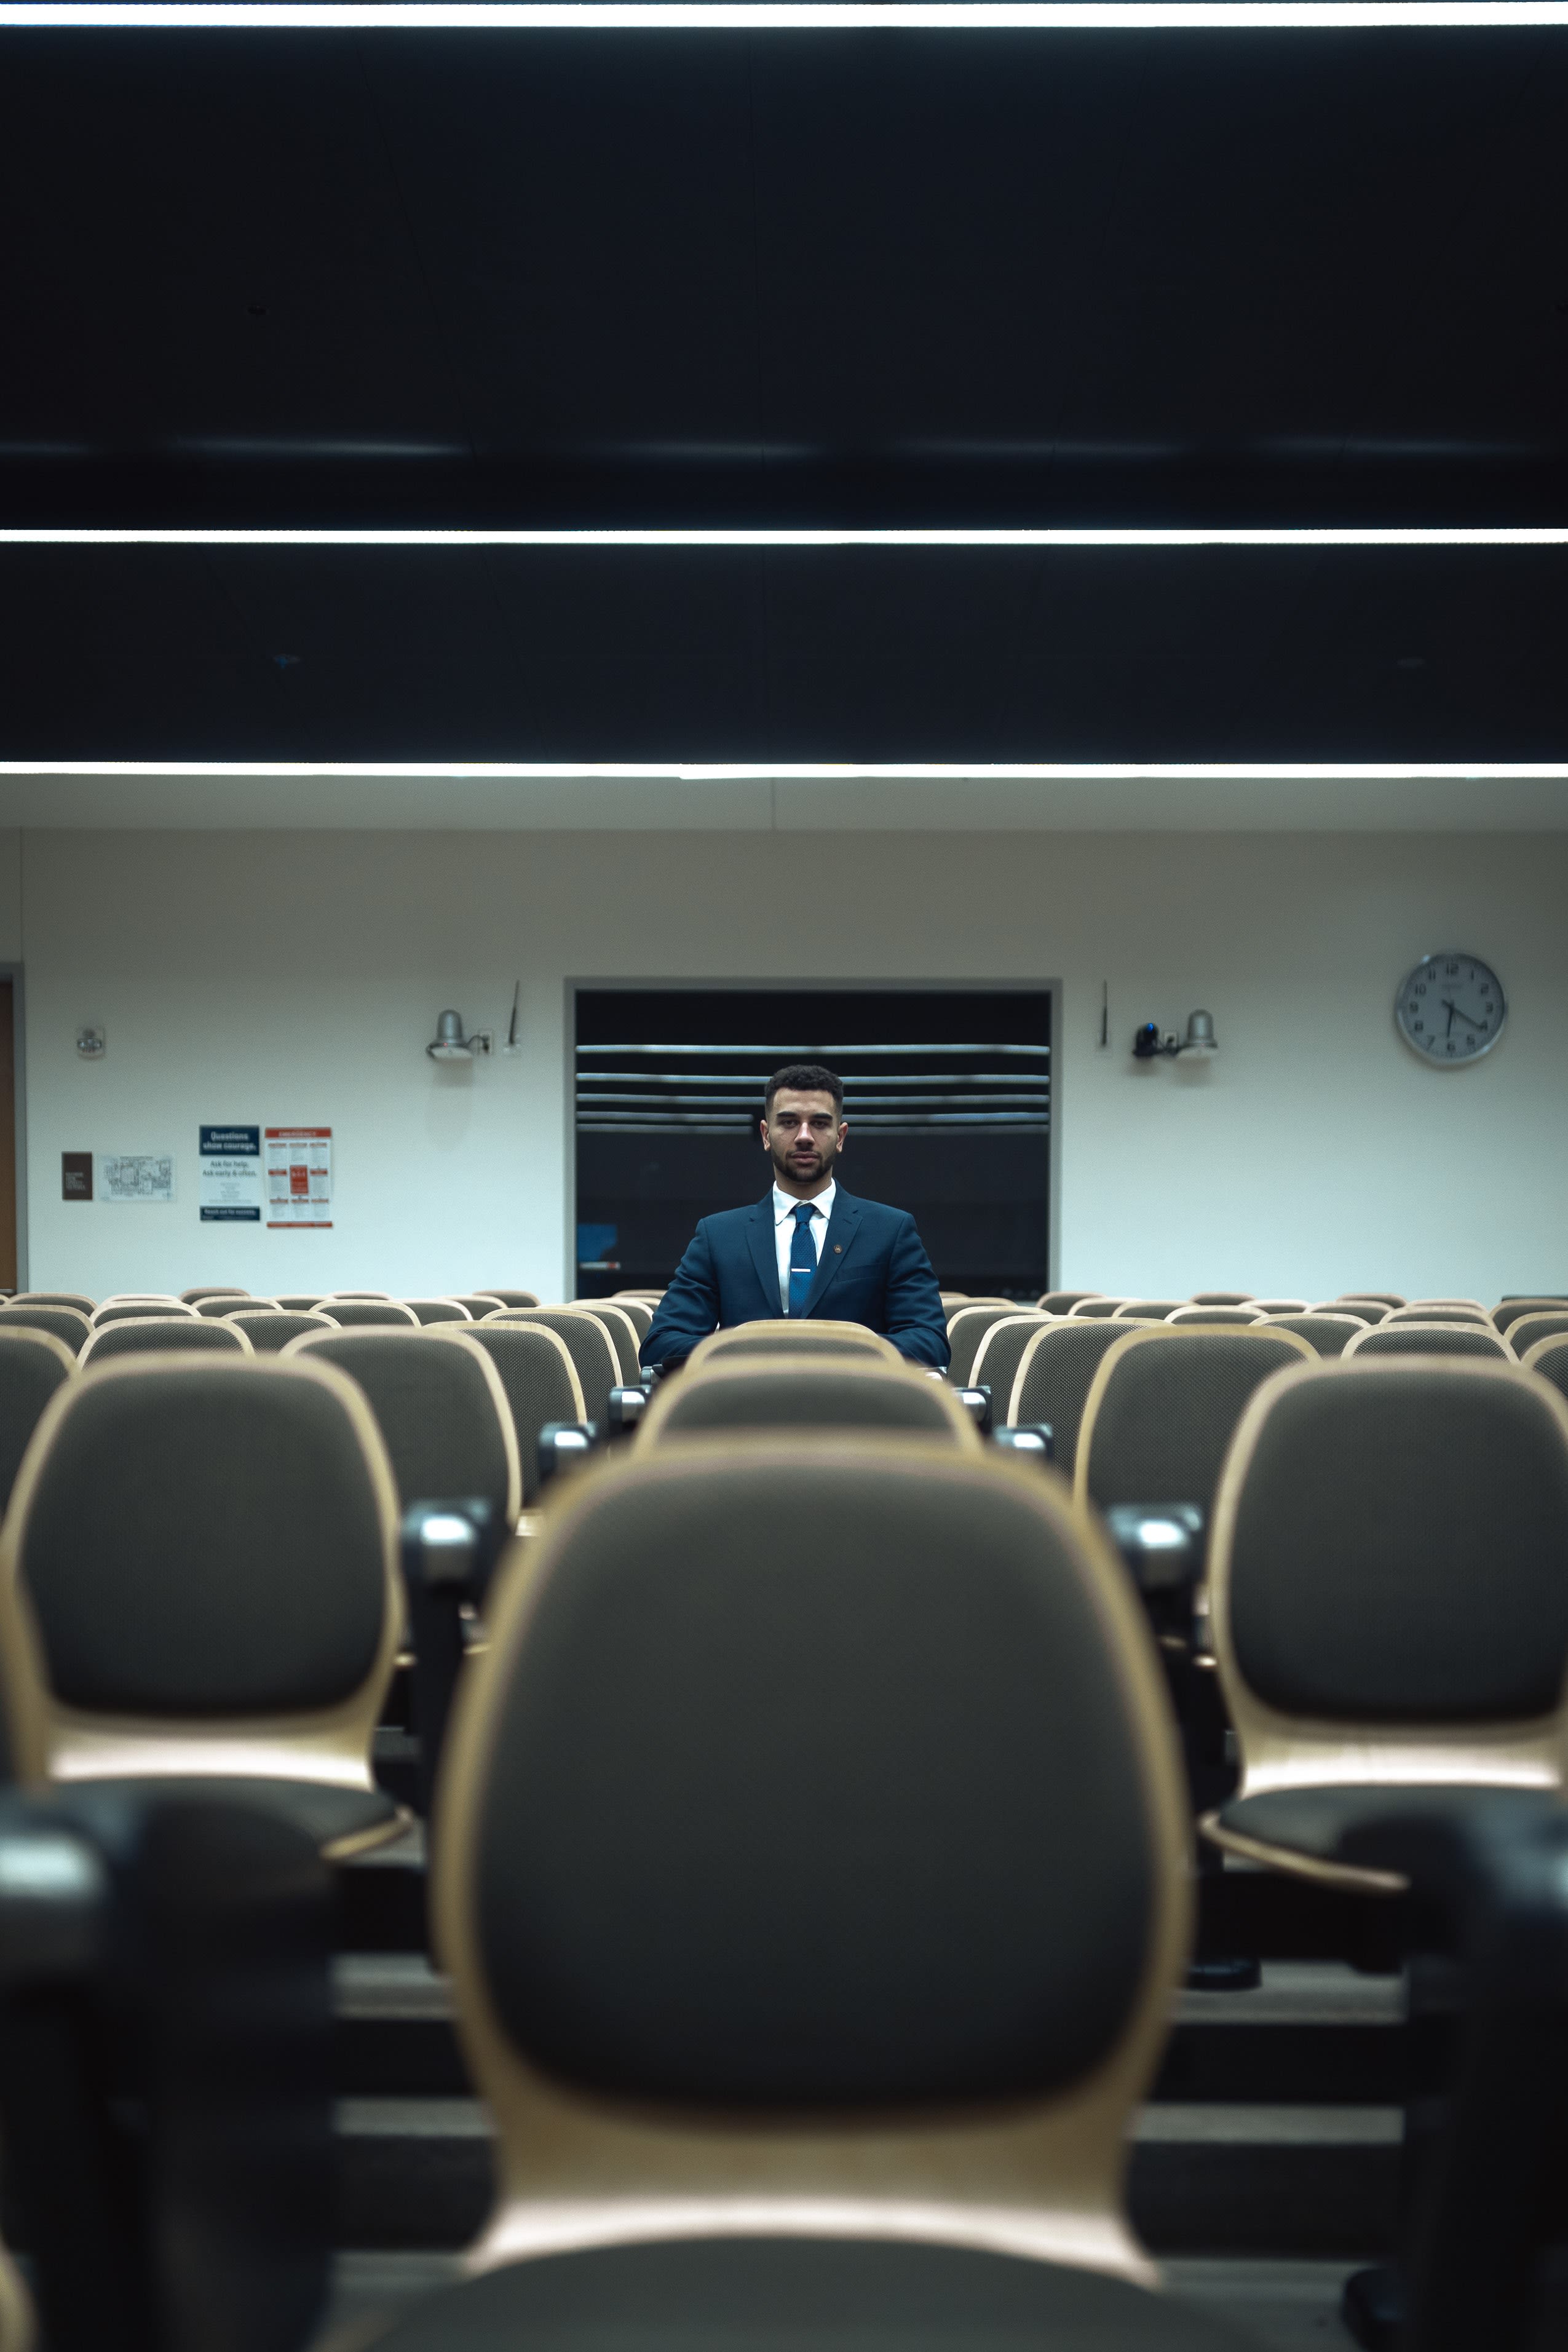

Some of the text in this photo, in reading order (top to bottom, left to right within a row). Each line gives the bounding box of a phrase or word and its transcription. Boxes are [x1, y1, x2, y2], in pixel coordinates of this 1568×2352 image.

[1428, 968, 1436, 980] 11
[1446, 963, 1459, 975] 12
[1471, 969, 1475, 980] 1
[1416, 984, 1427, 995] 10
[1415, 1021, 1423, 1032] 8
[1428, 1035, 1435, 1049] 7
[211, 1131, 248, 1141] Questions
[203, 1141, 222, 1150] show
